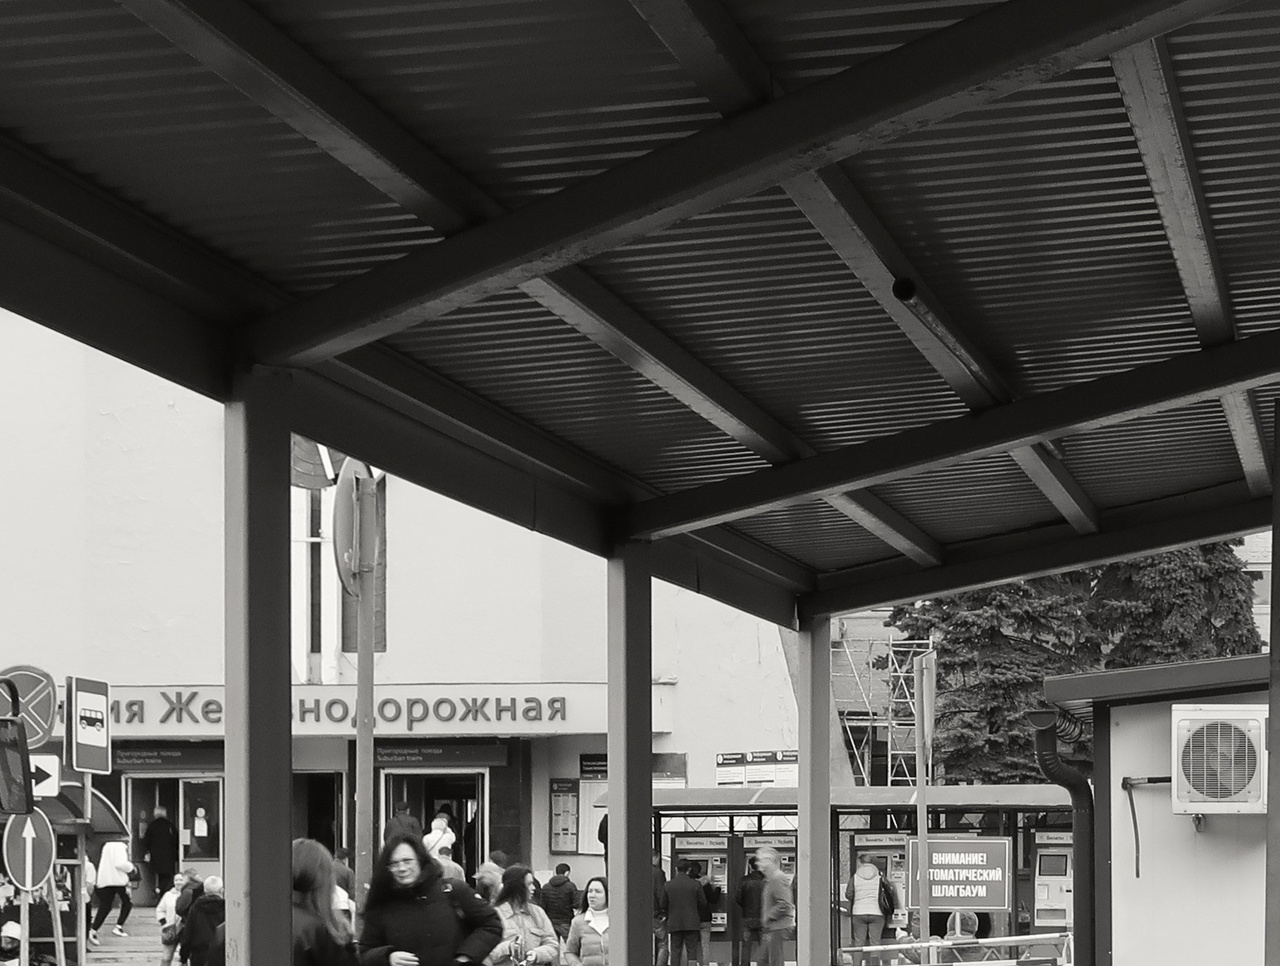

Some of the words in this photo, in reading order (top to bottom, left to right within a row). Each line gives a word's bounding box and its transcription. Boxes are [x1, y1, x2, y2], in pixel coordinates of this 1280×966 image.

[159, 691, 566, 731] Женоорожная
[932, 853, 987, 865] ВНИМАНИЕ!
[917, 868, 1002, 881] ТОМАТИЧЕСКИЙ
[932, 885, 987, 897] ШЛАГБАУМ
